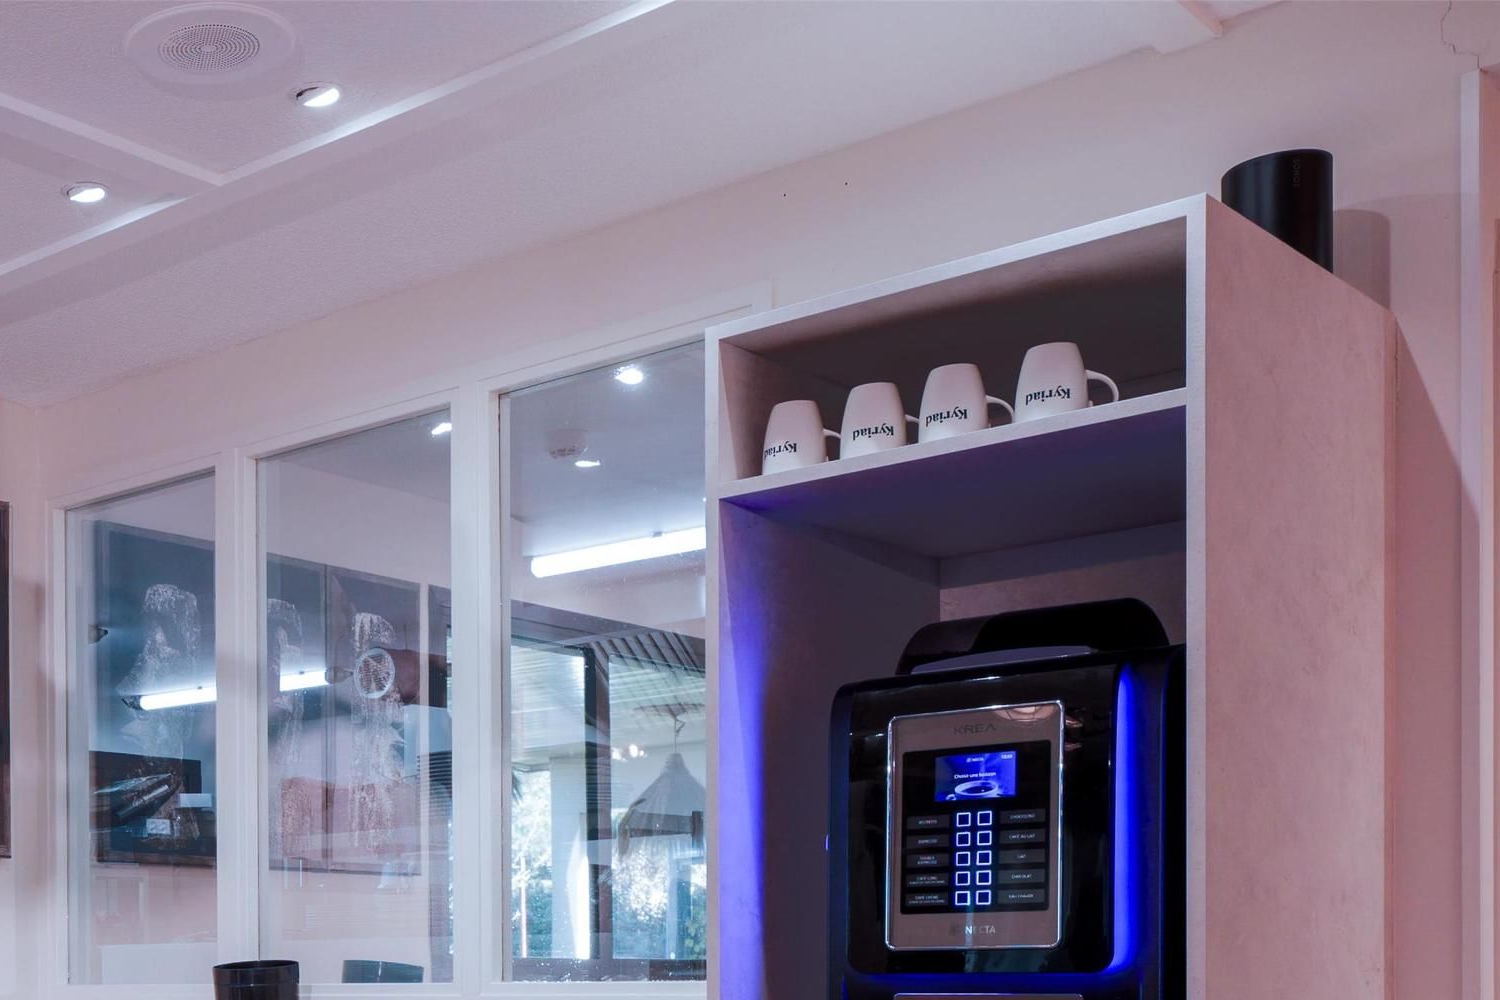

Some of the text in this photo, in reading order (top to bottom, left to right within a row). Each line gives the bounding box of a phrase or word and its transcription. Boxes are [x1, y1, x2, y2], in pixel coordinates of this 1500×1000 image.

[1025, 385, 1071, 406] Kyriad
[925, 406, 969, 428] Kyriad
[852, 422, 895, 441] Kyriad
[964, 925, 997, 936] NECTA
